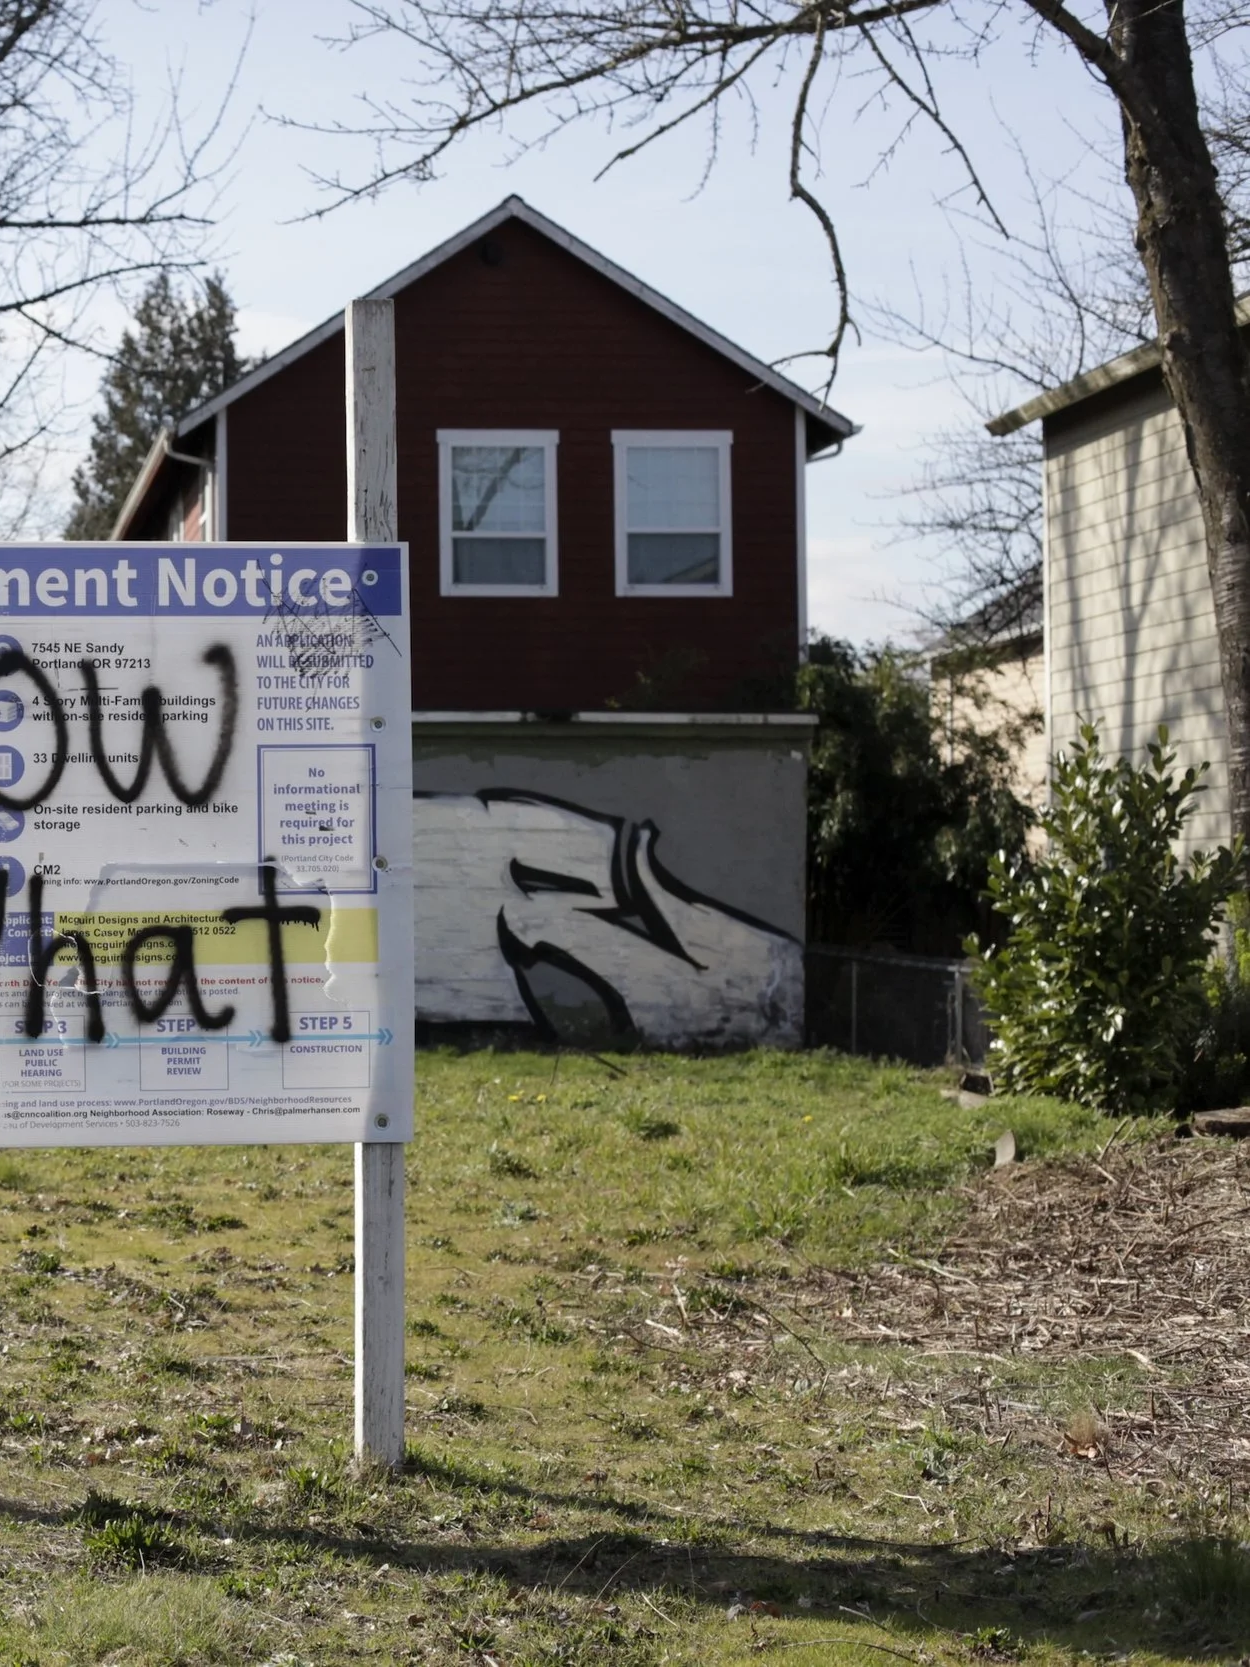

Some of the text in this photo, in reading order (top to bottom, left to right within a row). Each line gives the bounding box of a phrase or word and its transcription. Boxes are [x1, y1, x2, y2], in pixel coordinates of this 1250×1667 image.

[157, 553, 352, 608] Notice
[256, 634, 352, 648] AN APPLICATION
[32, 642, 125, 655] 7545 NE Sandy
[32, 658, 151, 669] Portland OR 97213
[256, 655, 286, 668] WILL
[306, 654, 374, 669] SUBMITTED
[256, 675, 350, 689] TO THE CITY FOR
[32, 694, 216, 709] 4 Sory Mlti-Fam buildings
[257, 696, 360, 710] FUTURE CHANGES
[32, 709, 208, 724] wit on-se reside parking
[257, 717, 334, 731] ON THIS SITE.
[33, 753, 48, 764] 33
[108, 752, 139, 763] units
[308, 767, 325, 778] No
[273, 783, 361, 795] informational
[33, 802, 239, 816] On-site resident parking and bike
[285, 799, 350, 813] meeting is
[33, 819, 81, 832] storage
[279, 816, 355, 830] required for
[281, 833, 353, 846] this project
[281, 854, 354, 864] (Portland City Code
[33, 864, 61, 875] CM2
[63, 877, 82, 886] info:
[84, 875, 240, 887] www.PortlandOregon.gov/ZoningCode
[59, 914, 95, 926] Mcguirl
[98, 914, 139, 926] Designs
[142, 914, 160, 924] and
[162, 913, 225, 924] Architecture
[93, 927, 129, 939] Casey
[212, 925, 236, 935] 0522
[135, 979, 152, 987] not
[200, 977, 216, 986] the
[219, 977, 256, 985] content
[258, 976, 268, 985] of
[290, 976, 325, 985] notice.
[14, 1020, 67, 1034] SP 3
[156, 1019, 196, 1033] STEP
[299, 1016, 353, 1031] STEP 5
[19, 1049, 64, 1057] LAND USE
[161, 1047, 206, 1055] BUILDING
[289, 1045, 363, 1054] CONSTRUCTION
[25, 1059, 58, 1067] PUBLIC
[166, 1057, 201, 1065] PERMIT
[20, 1069, 62, 1077] HEARING
[166, 1067, 201, 1075] REVIEW
[21, 1080, 42, 1088] SOME
[20, 1099, 37, 1108] and
[38, 1099, 58, 1108] land
[60, 1100, 76, 1108] use
[77, 1099, 112, 1110] process:
[113, 1095, 352, 1107] www.PortlandOregon.gov/BDS/NeighborhoodResources
[90, 1108, 150, 1119] Neighborhood
[151, 1107, 205, 1117] Association:
[206, 1107, 244, 1118] Roseway
[251, 1106, 361, 1116] Chris@palmerhansen.com
[20, 1120, 29, 1129] of
[29, 1119, 85, 1130] Development
[85, 1118, 119, 1128] Services
[125, 1117, 181, 1127] 503-823-7526
